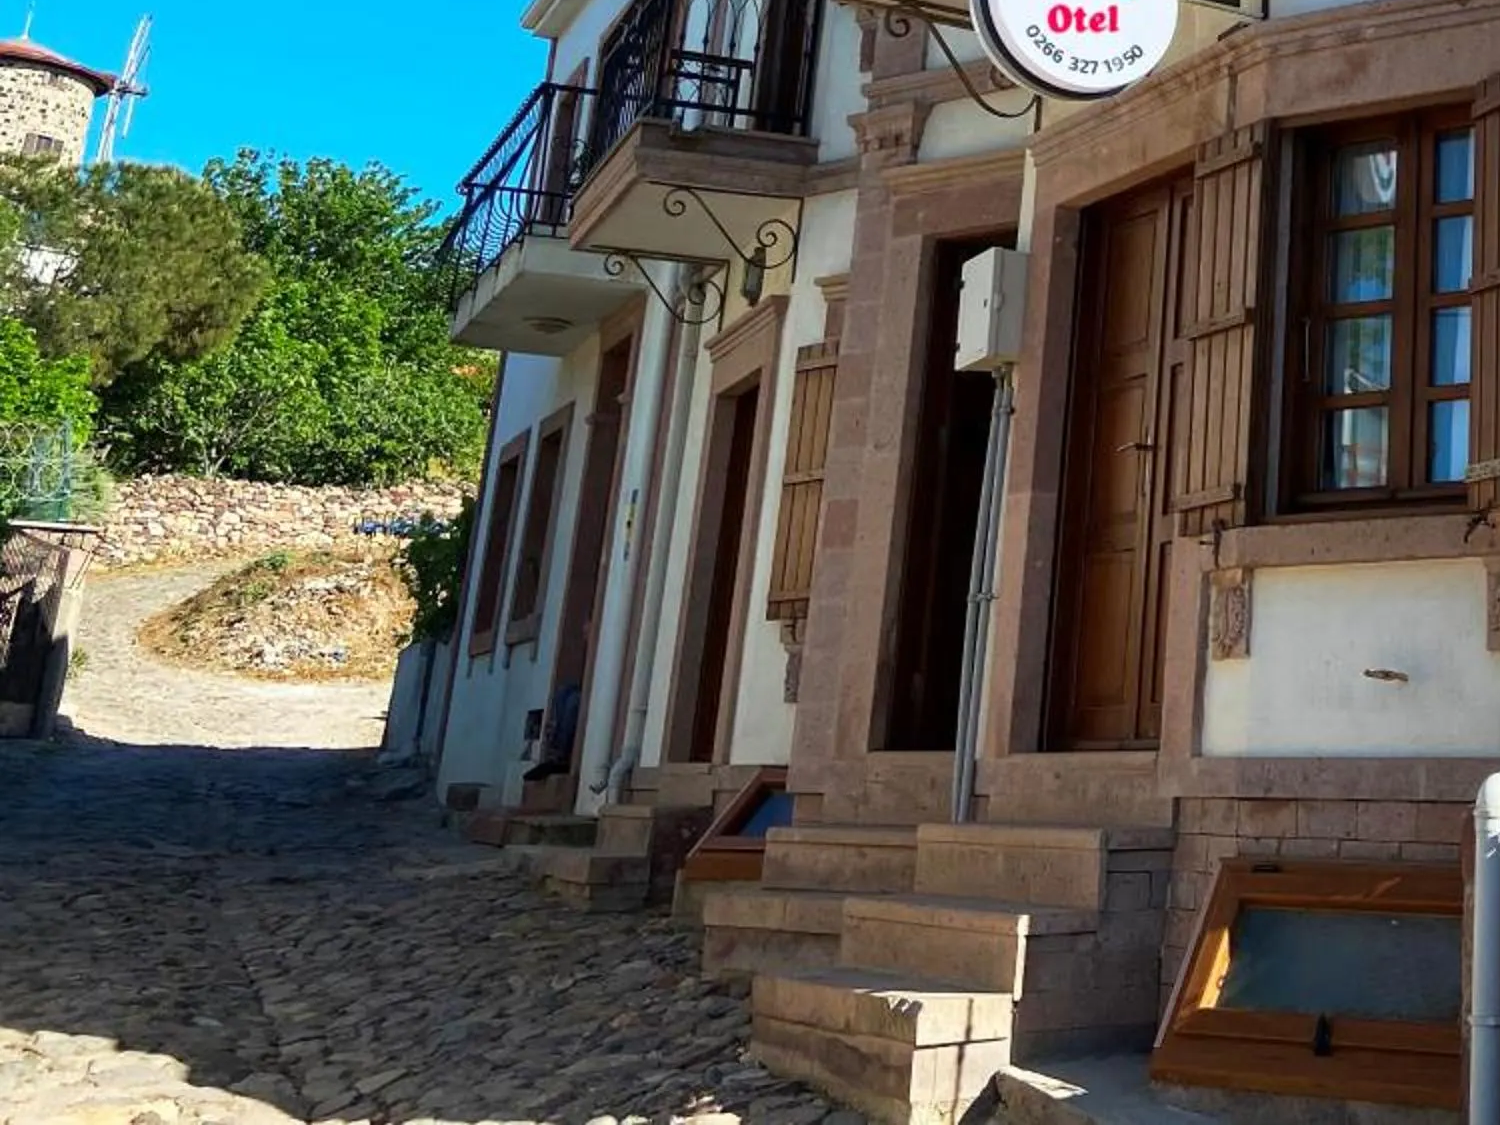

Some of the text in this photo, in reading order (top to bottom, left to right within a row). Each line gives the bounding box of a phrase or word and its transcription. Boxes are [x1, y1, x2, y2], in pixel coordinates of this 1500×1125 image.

[1047, 4, 1119, 33] Otel
[1026, 24, 1144, 75] 0266 327 1950
